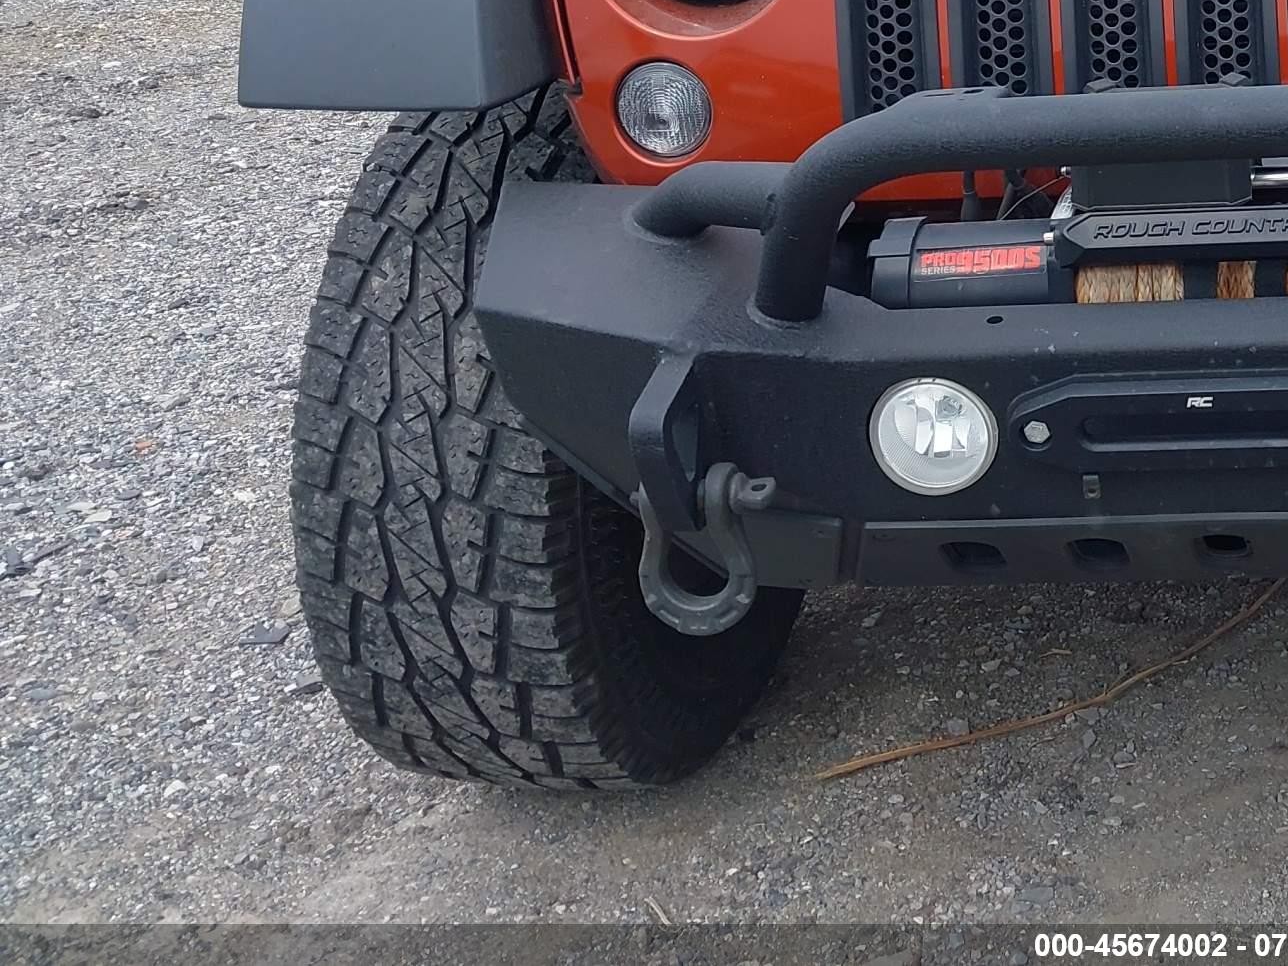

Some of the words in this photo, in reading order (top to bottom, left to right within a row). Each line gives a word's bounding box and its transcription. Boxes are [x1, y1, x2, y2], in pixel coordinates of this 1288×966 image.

[1094, 220, 1185, 239] ROUGH
[920, 265, 956, 275] SERIES
[1186, 396, 1214, 408] RC
